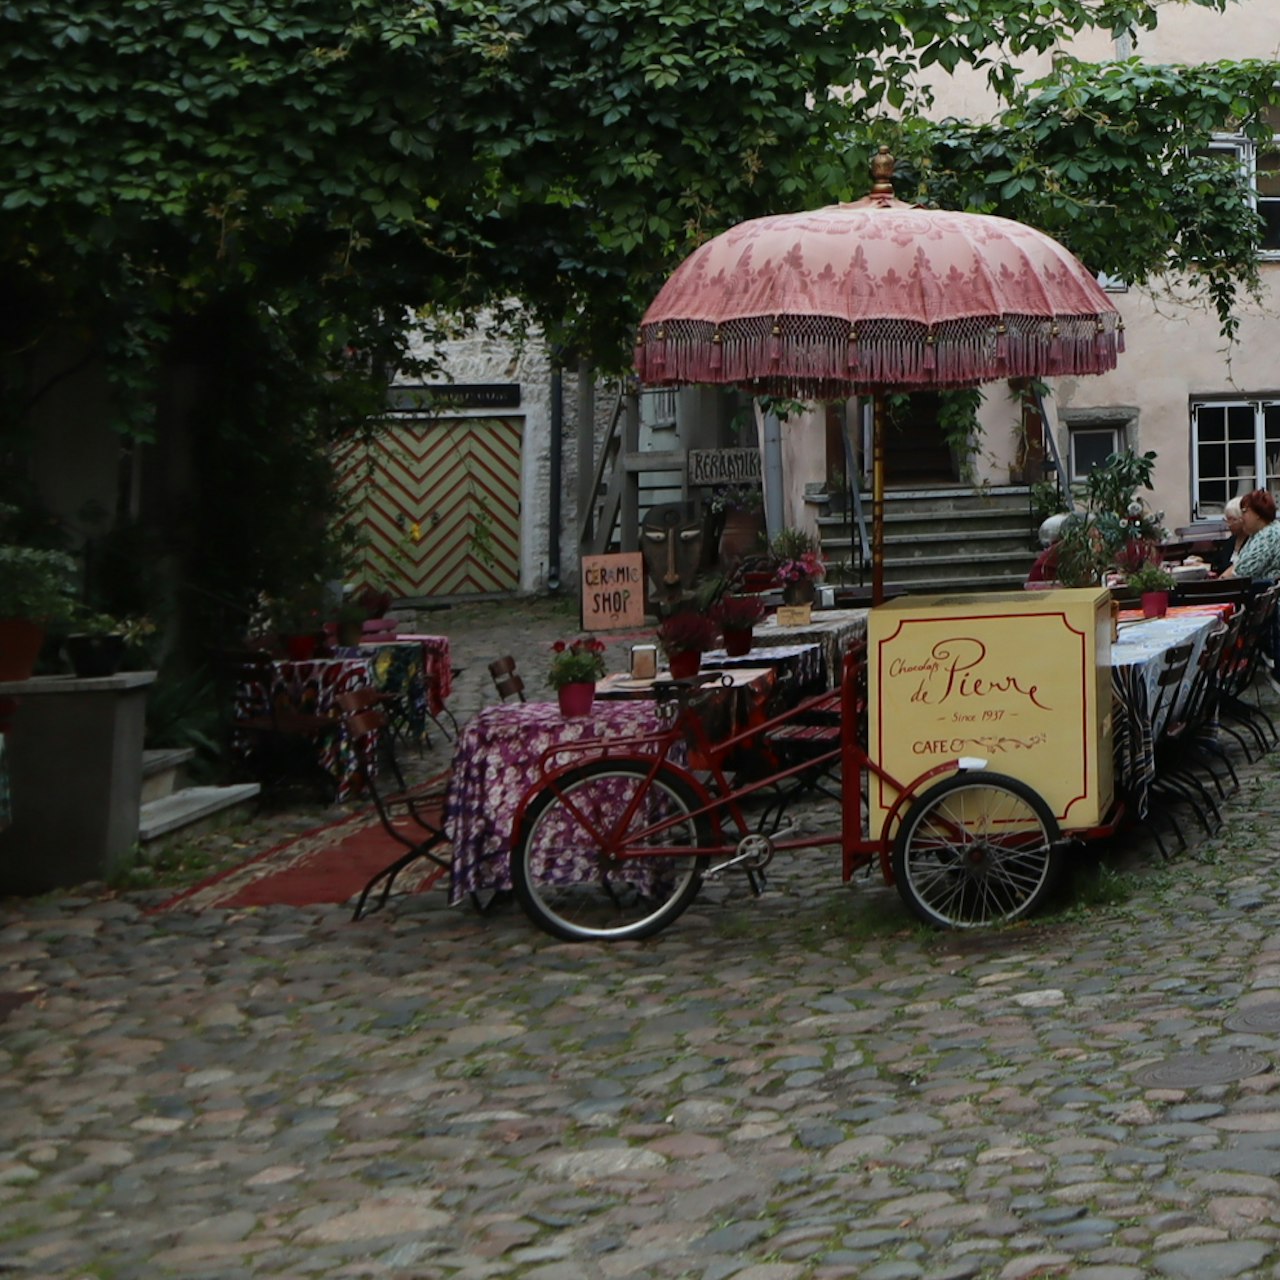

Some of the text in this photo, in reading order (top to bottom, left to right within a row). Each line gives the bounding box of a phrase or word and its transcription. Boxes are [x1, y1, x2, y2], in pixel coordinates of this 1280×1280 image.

[592, 589, 631, 613] SHOP
[910, 637, 1054, 711] de Pierre
[951, 710, 1005, 723] Since 1937
[912, 739, 948, 755] CAFE
